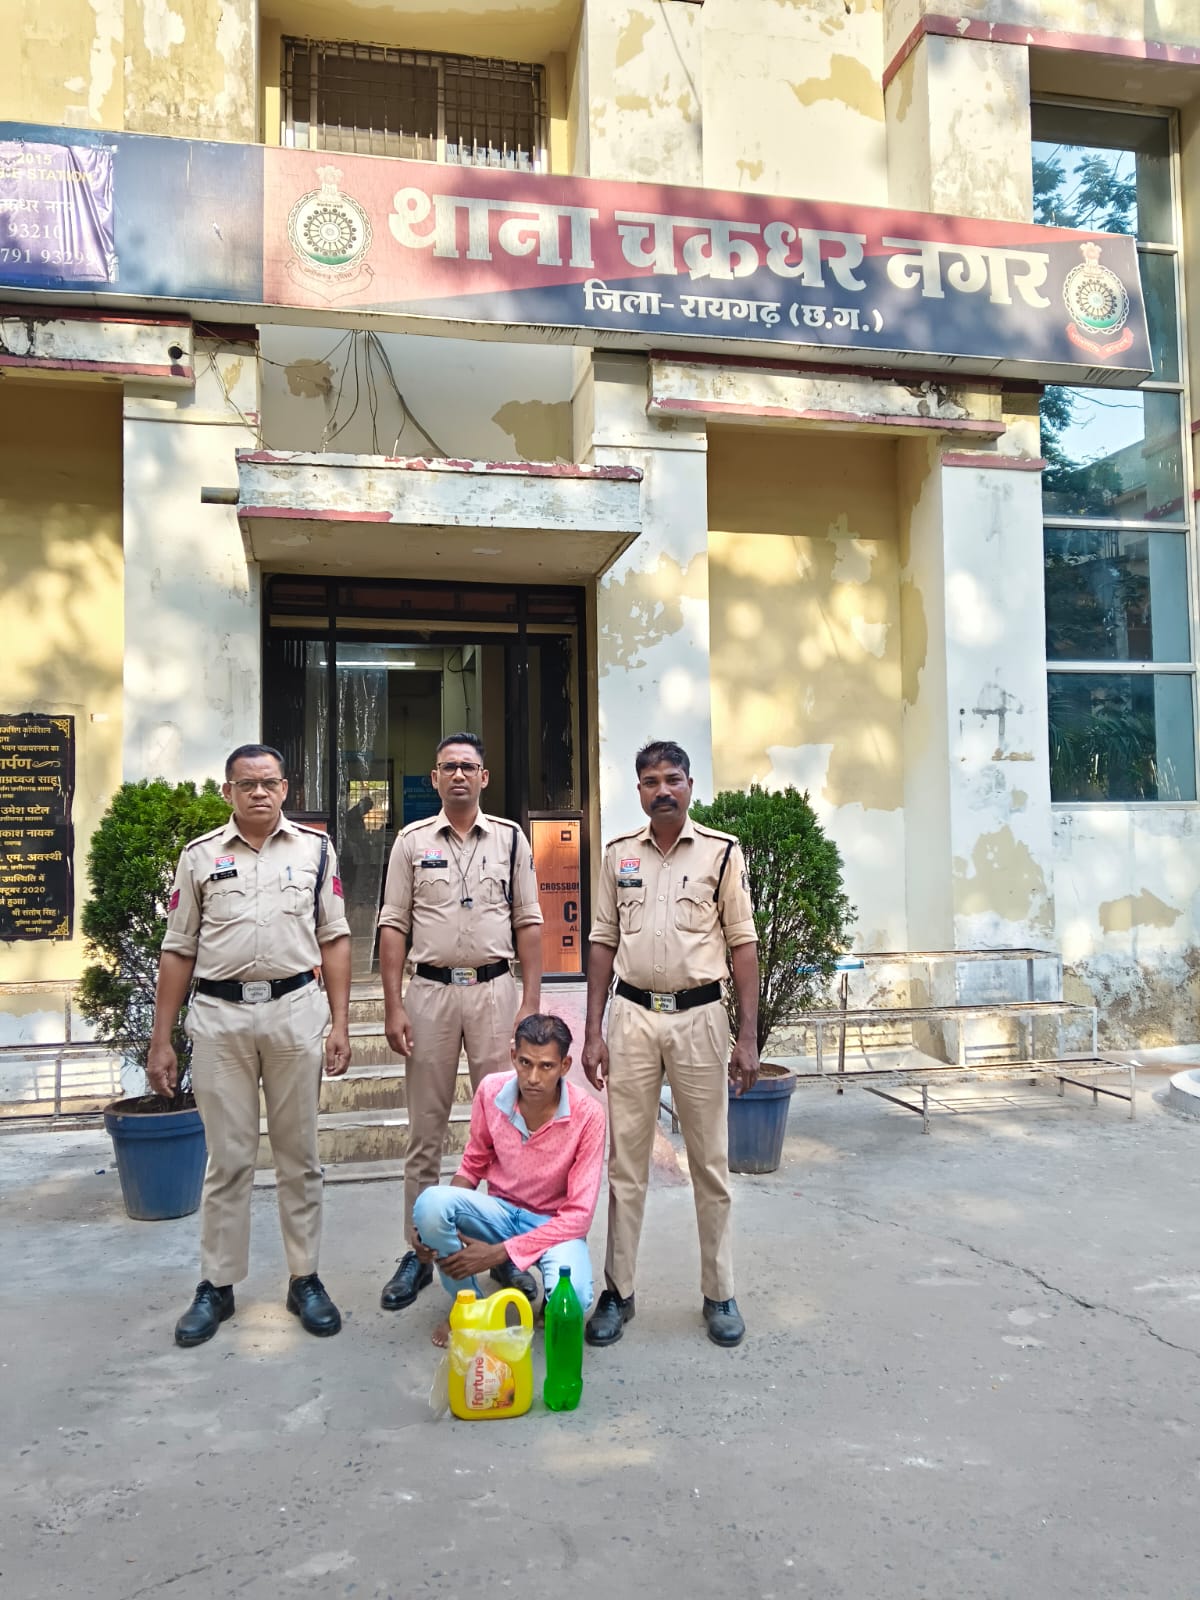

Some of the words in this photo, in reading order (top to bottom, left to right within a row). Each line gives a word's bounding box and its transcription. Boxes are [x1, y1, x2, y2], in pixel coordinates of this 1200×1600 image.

[388, 187, 599, 269] थाना
[614, 210, 867, 292] चक्रधर
[881, 236, 1051, 309] नगर
[1, 804, 24, 814] उमेश
[27, 804, 49, 814] पटेल
[26, 829, 55, 837] नायक
[27, 850, 62, 861] अवस्थी
[472, 1357, 484, 1406] fortune
